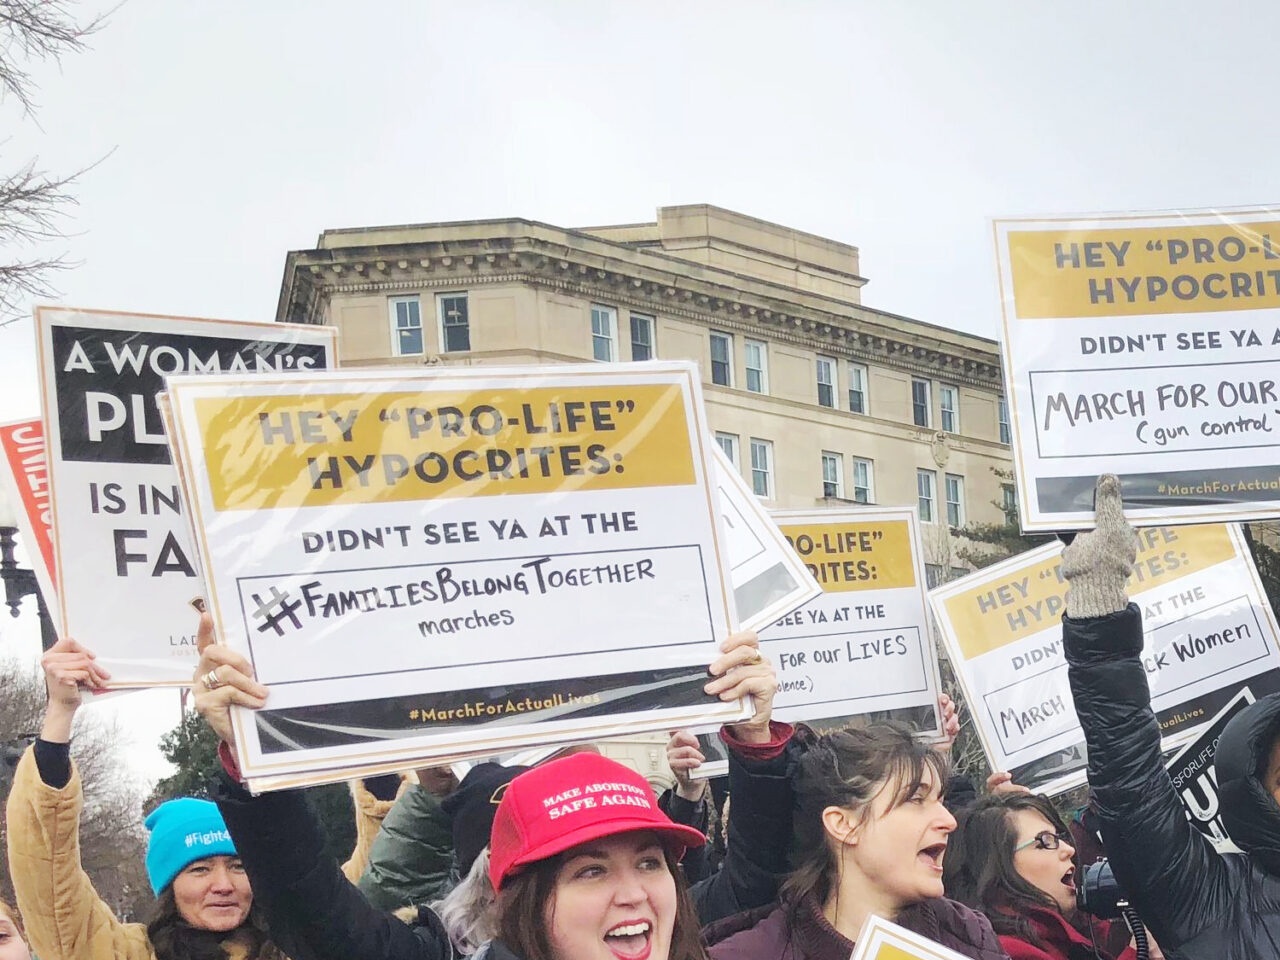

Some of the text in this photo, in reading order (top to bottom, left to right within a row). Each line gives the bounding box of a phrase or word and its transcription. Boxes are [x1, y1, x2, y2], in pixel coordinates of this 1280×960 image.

[1054, 240, 1131, 269] HEY
[63, 340, 96, 374] A
[1080, 333, 1167, 355] DIDN'T
[1177, 330, 1222, 350] SEE
[1230, 328, 1262, 347] YA
[1044, 389, 1145, 431] MARCH
[1157, 383, 1209, 411] FOR
[1219, 378, 1279, 409] OUR
[258, 399, 635, 445] HEY “PRO-LIFE”
[1136, 420, 1189, 446] (gun
[306, 443, 625, 490] HYPOCRITES:
[90, 482, 181, 516] IS IN
[302, 511, 639, 554] DIDN'T SEE YA AT THE
[786, 530, 883, 555] O-LIFE”
[810, 560, 878, 584] RITES:
[976, 575, 1029, 614] HEY
[417, 607, 515, 638] marches
[807, 609, 828, 624] YA
[833, 607, 850, 622] AT
[855, 605, 886, 620] THE
[1011, 586, 1206, 671] DIDN' AT THE
[170, 635, 198, 647] LAD
[780, 651, 806, 671] FOR
[847, 635, 908, 663] LIVES
[775, 675, 814, 694] olence)
[999, 693, 1066, 738] MARCH
[1172, 621, 1251, 663] Women
[408, 692, 601, 723] #MarchForActualLives
[543, 781, 646, 807] MAKE ABORTION
[548, 794, 651, 820] SAFE AGAIN
[185, 830, 230, 848] #Fight4
